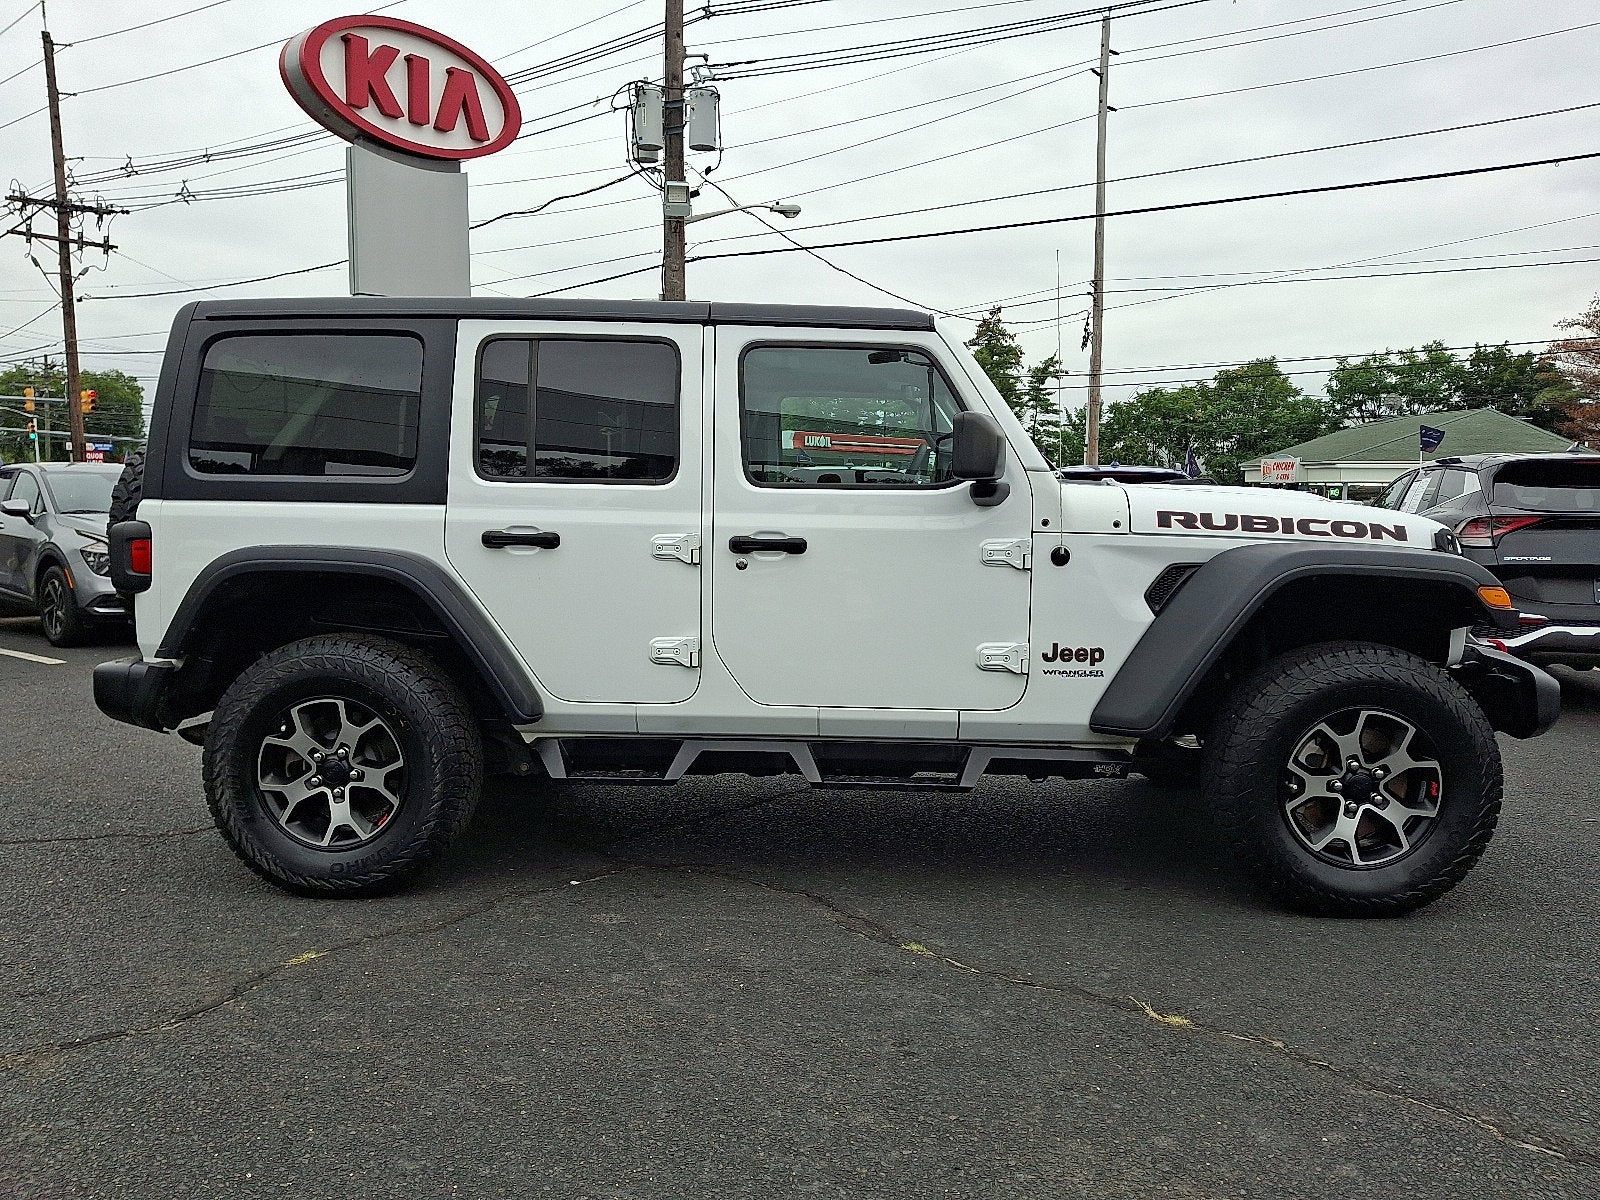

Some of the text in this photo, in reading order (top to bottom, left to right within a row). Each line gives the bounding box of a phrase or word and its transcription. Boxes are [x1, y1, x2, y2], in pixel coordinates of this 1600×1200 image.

[340, 32, 491, 143] KIA
[804, 435, 832, 448] LUKOIL
[1272, 461, 1296, 471] CHICKEN
[1156, 510, 1409, 542] RUBICON
[1041, 642, 1105, 667] Jeep
